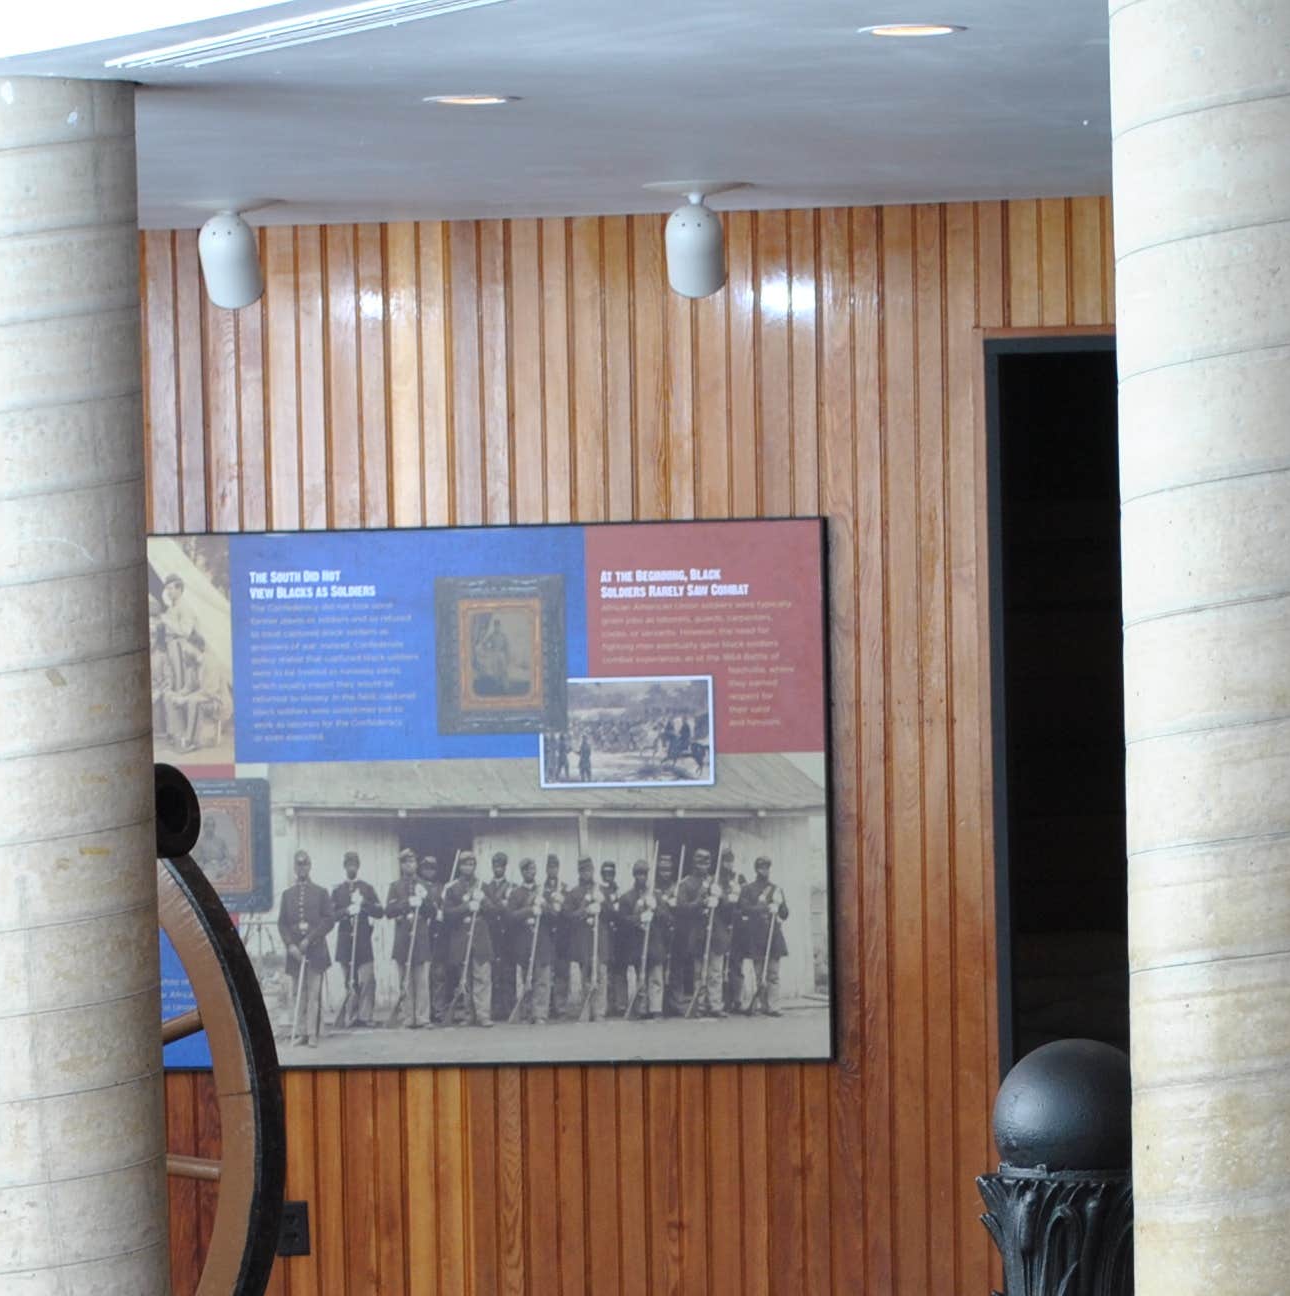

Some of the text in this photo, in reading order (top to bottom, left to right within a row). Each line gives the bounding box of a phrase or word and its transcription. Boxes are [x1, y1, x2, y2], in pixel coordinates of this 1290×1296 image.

[249, 570, 341, 584] THE SOUTH DID NOT
[600, 569, 721, 583] AT THE BEGINNING, BLACK
[249, 585, 376, 600] VIEW BLACKS AS SOLDIERS
[601, 584, 749, 599] SOLDIERS RARELY SAW COMBAT
